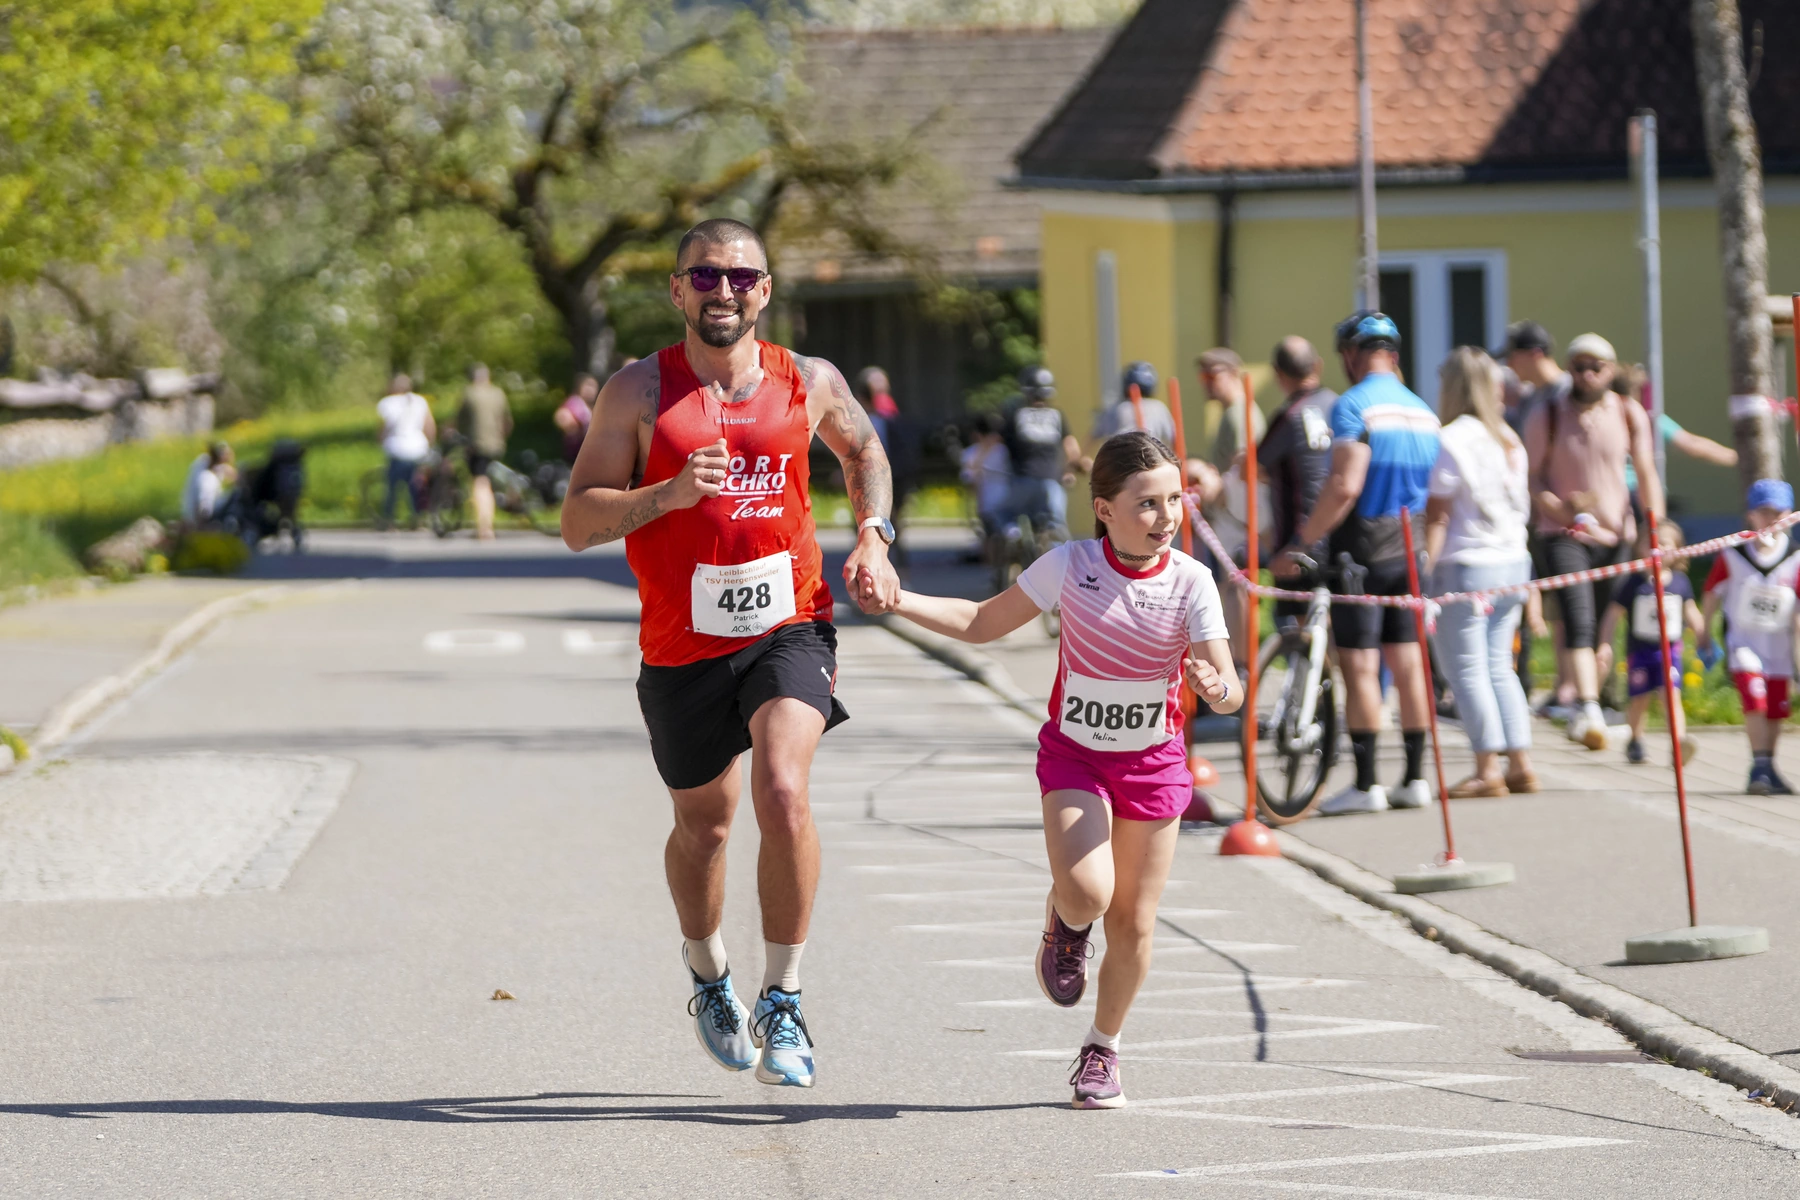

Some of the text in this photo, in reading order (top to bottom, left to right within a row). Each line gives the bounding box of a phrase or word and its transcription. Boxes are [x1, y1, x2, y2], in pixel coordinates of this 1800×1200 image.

[688, 453, 792, 473] ORT
[718, 471, 787, 491] SCHKO
[731, 496, 784, 520] Team
[724, 568, 780, 585] Hergensweiler
[1078, 582, 1100, 592] erima
[717, 582, 771, 613] 428
[733, 613, 759, 622] Patrick
[730, 624, 752, 633] AOK
[1064, 695, 1164, 730] 20867
